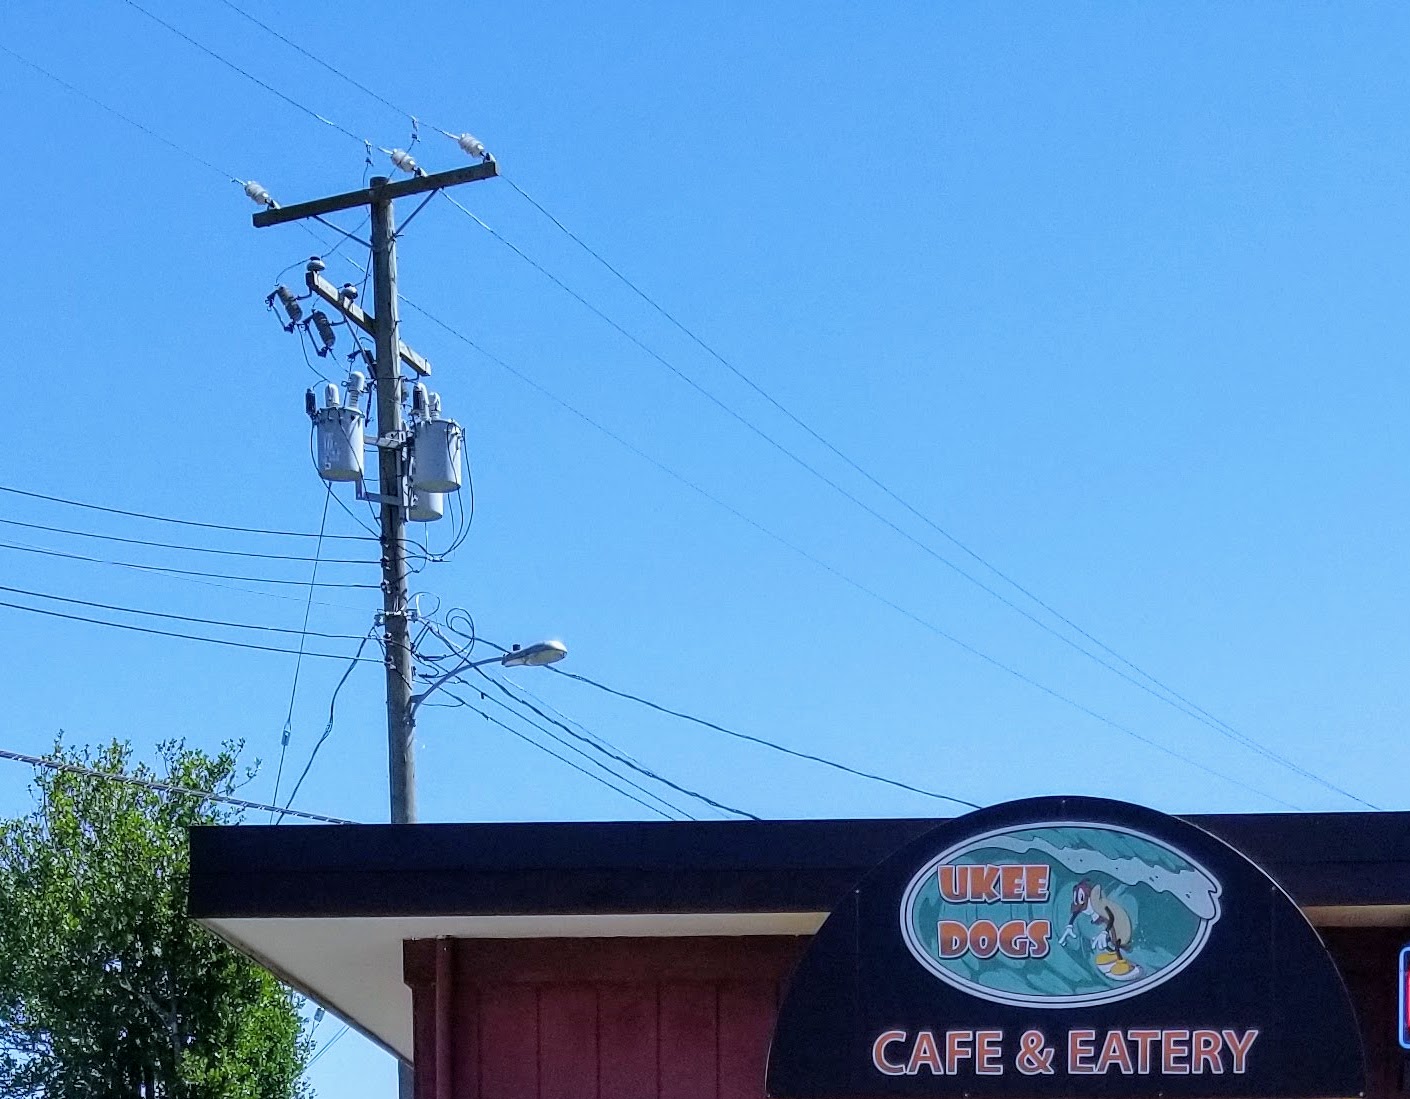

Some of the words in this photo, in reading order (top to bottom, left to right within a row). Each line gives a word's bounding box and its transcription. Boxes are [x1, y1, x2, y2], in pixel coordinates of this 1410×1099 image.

[938, 864, 1050, 903] UKEE
[937, 920, 1051, 959] DOGS
[872, 1030, 1003, 1076] CAFE
[1015, 1030, 1055, 1076] &
[1067, 1029, 1259, 1075] EATERY
